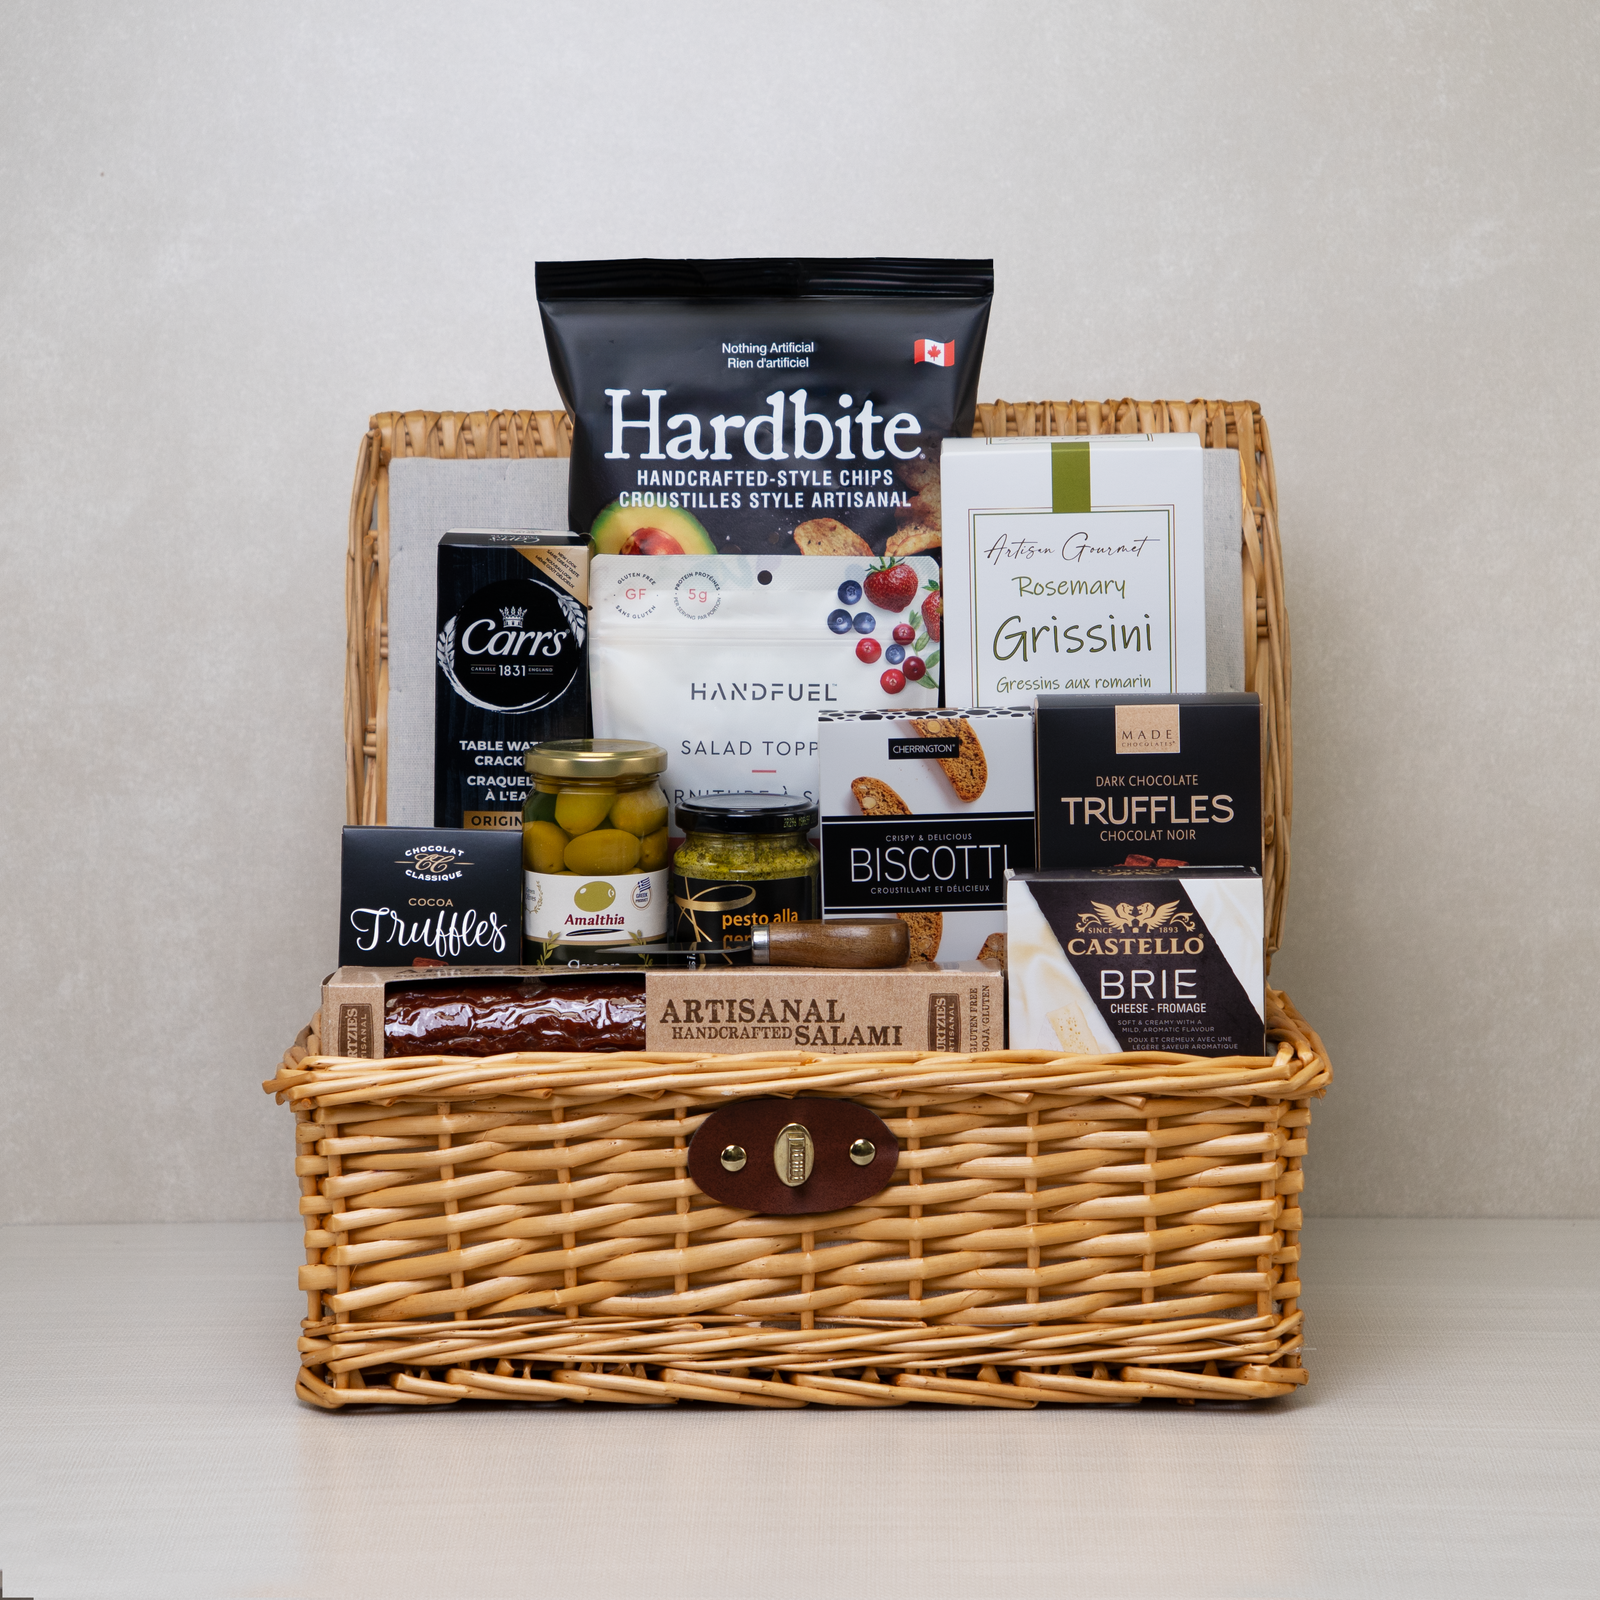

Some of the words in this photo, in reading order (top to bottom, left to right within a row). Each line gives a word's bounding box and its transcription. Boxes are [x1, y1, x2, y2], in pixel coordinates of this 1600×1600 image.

[722, 343, 767, 357] Nothing
[769, 342, 814, 354] Artificial
[727, 358, 754, 369] Rien
[757, 357, 809, 369] d'artificiel
[604, 388, 922, 461] Hardbite
[637, 470, 833, 487] HANDCRAFTED-STYLE
[839, 469, 894, 486] CHIPS
[619, 491, 742, 509] CROUSTILLES
[749, 492, 804, 509] STYLE
[811, 491, 912, 508] ARTISANAL
[984, 533, 1055, 566] Artisan
[1061, 531, 1161, 563] Gourmet
[617, 572, 641, 585] GLUTEN
[642, 573, 656, 586] FREE
[674, 572, 694, 591] PROTEIN
[694, 571, 721, 591] PROTÉINES
[625, 588, 647, 600] GF
[1011, 575, 1126, 600] Rosemary
[615, 604, 631, 618] SANS
[631, 605, 657, 620] GLUTEN
[461, 618, 567, 657] Carr's
[992, 613, 1153, 662] Grissini
[499, 664, 526, 677] 1831
[996, 676, 1060, 693] Gressins
[1064, 678, 1091, 690] aux
[1094, 674, 1152, 689] romarin
[691, 682, 838, 702] HANDFUEL
[1121, 729, 1173, 741] MADE
[459, 740, 504, 751] TABLE
[681, 740, 752, 756] SALAD
[892, 744, 953, 755] CHERRINGTON
[474, 755, 525, 766] CRACK
[1096, 775, 1126, 787] DARK
[1128, 774, 1199, 787] CHOCOLATE
[485, 788, 496, 801] À
[1061, 794, 1235, 825] TRUFFLES
[885, 834, 915, 842] CRISPY
[927, 832, 973, 841] DELICIOUS
[1100, 829, 1164, 842] CHOCOLAT
[1166, 829, 1196, 841] NOIR
[404, 845, 465, 857] CHOCOLAT
[850, 844, 1008, 883] BISCOTTI
[405, 869, 463, 882] CLASSIQUE
[870, 885, 931, 895] CROUSTILLANT
[934, 885, 944, 893] ET
[947, 883, 990, 893] DÉLICIEUX
[408, 897, 454, 907] COCOA
[564, 913, 625, 926] Amalthia
[722, 911, 769, 930] pesto
[350, 907, 508, 958] Truffles
[1067, 937, 1205, 956] CASTELLO
[1100, 969, 1197, 999] BRIE
[969, 987, 978, 1013] FREE
[1110, 1003, 1149, 1014] CHEESE
[1157, 1002, 1207, 1013] FROMAGE
[659, 998, 846, 1024] ARTISANAL
[671, 1026, 793, 1041] HANDCRAFTED
[794, 1025, 903, 1047] SALAMI
[1161, 1035, 1195, 1043] CRÉMEUX
